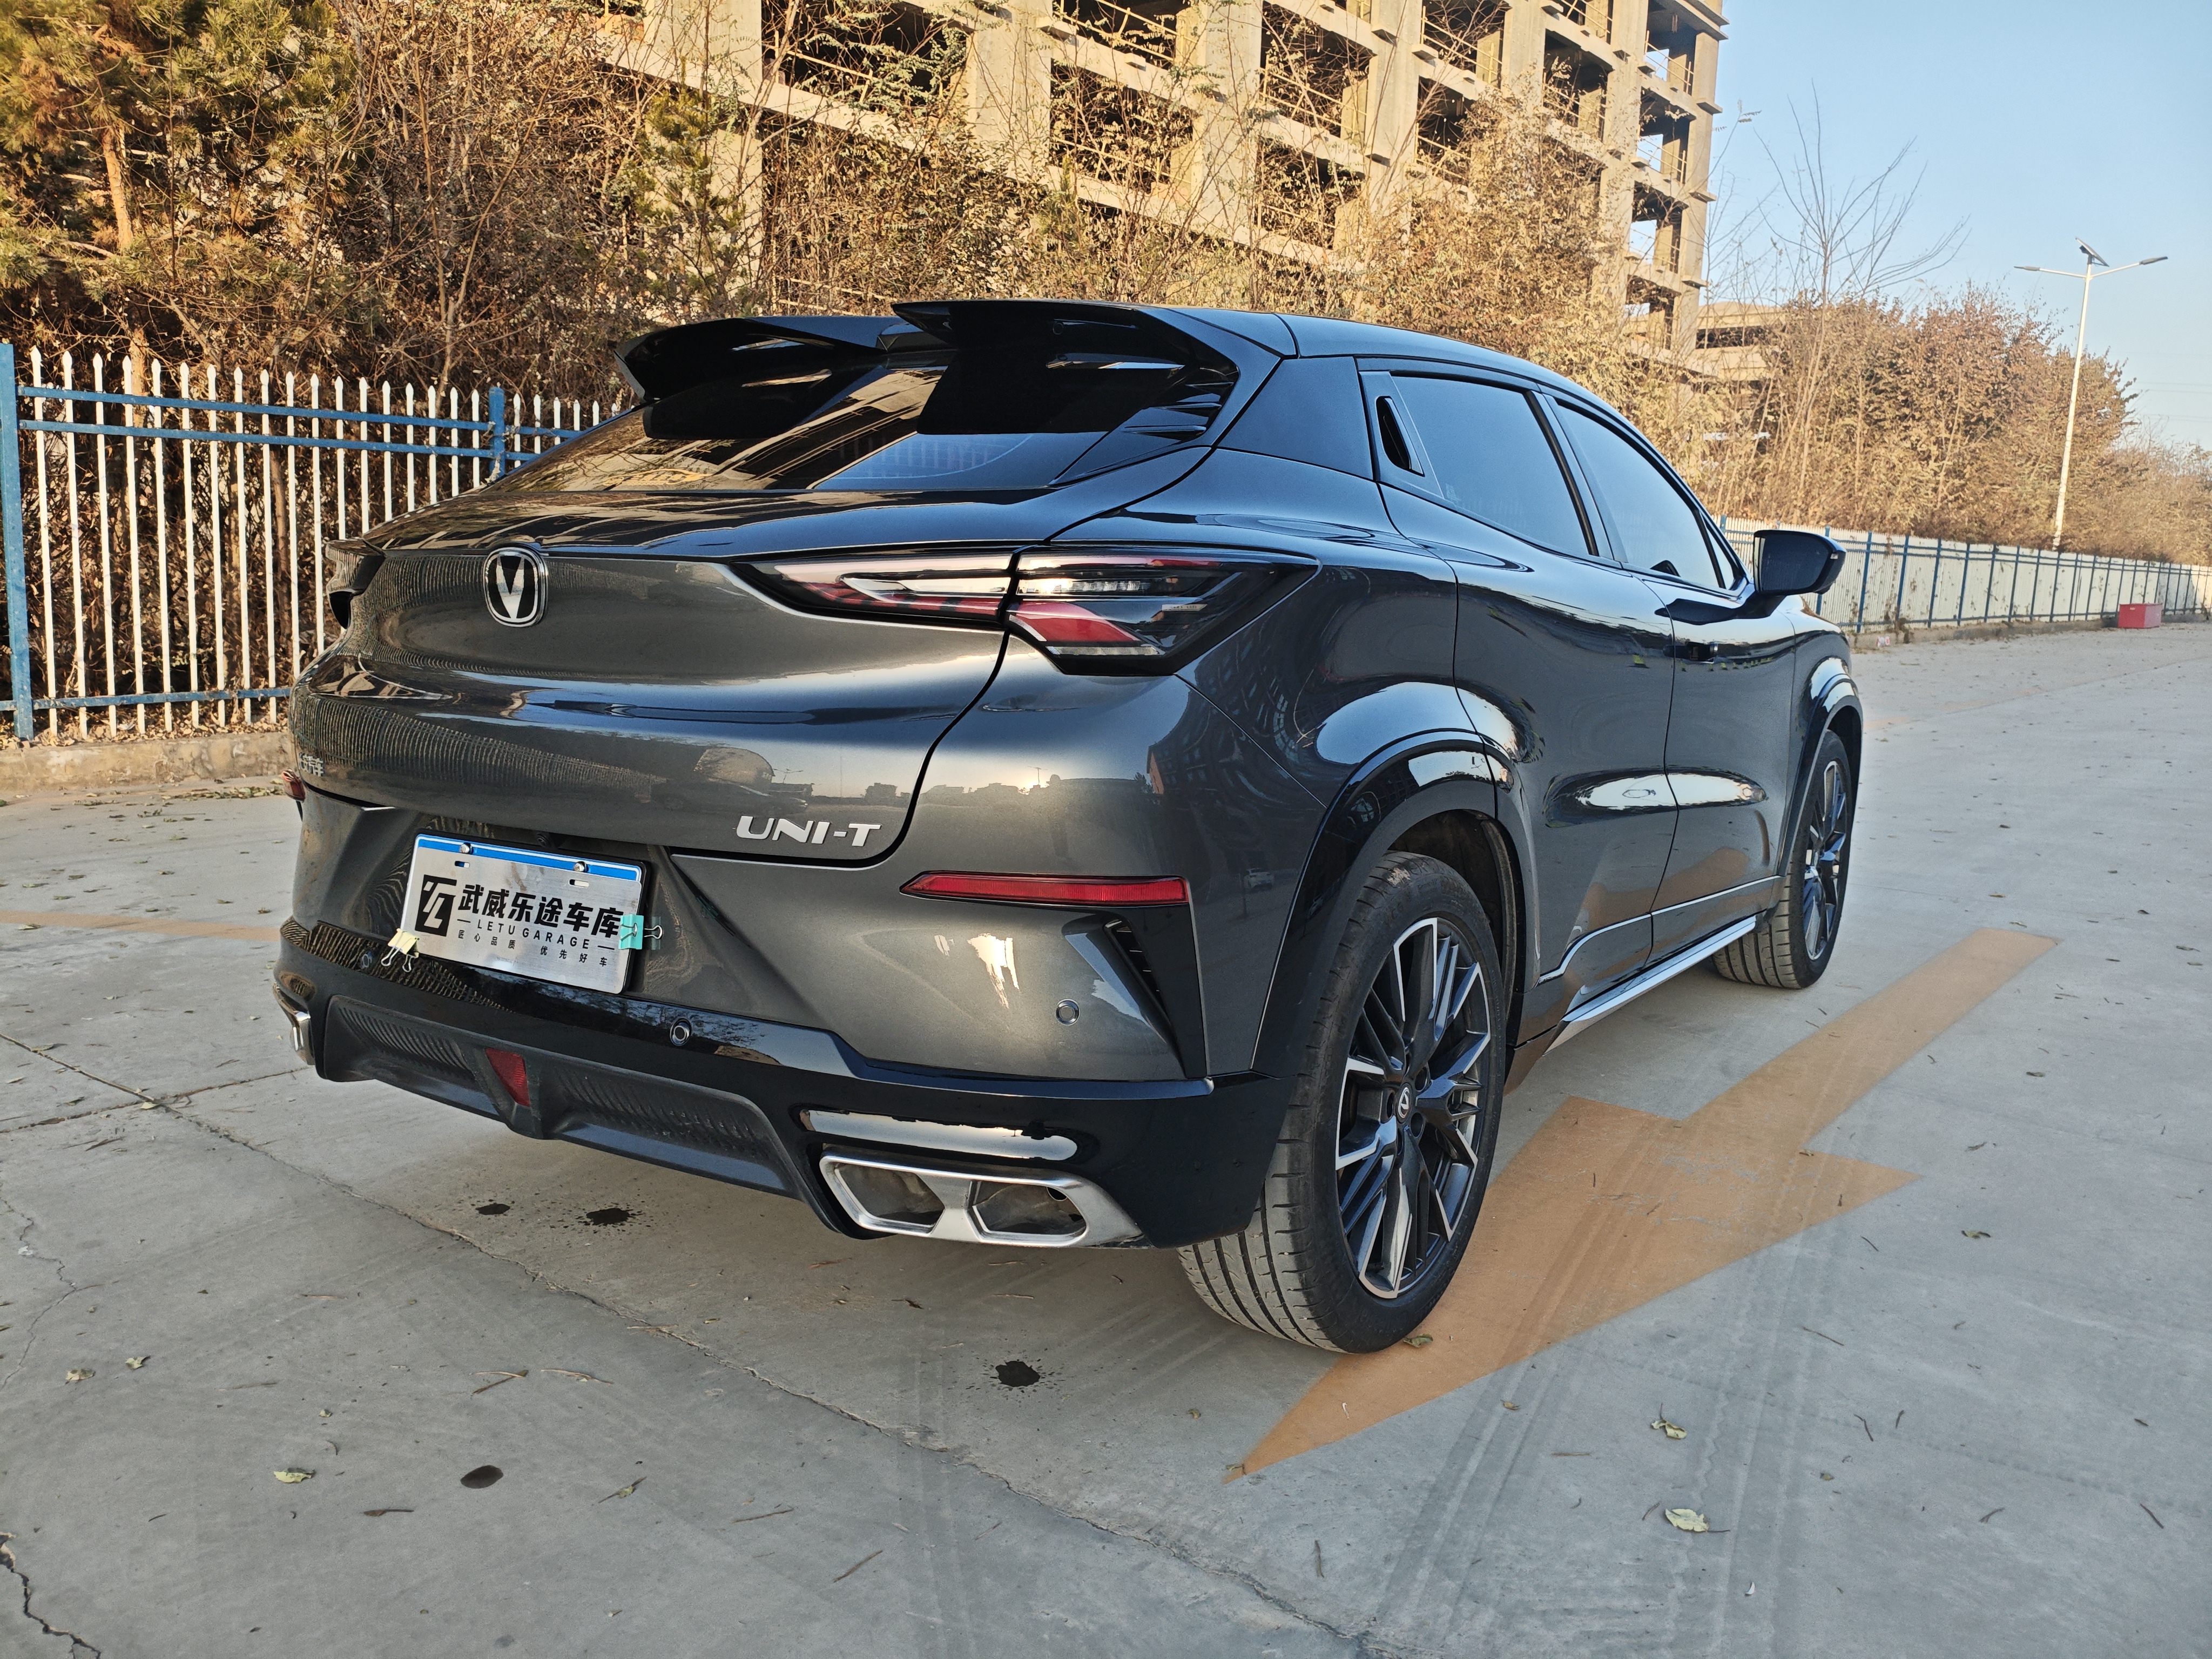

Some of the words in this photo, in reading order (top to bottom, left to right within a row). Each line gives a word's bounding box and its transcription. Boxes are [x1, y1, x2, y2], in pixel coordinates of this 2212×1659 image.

[736, 815, 882, 847] UNI-T
[457, 884, 624, 938] 武威乐途车库
[458, 929, 516, 949] 匠心品质
[540, 945, 608, 967] 优先好车
